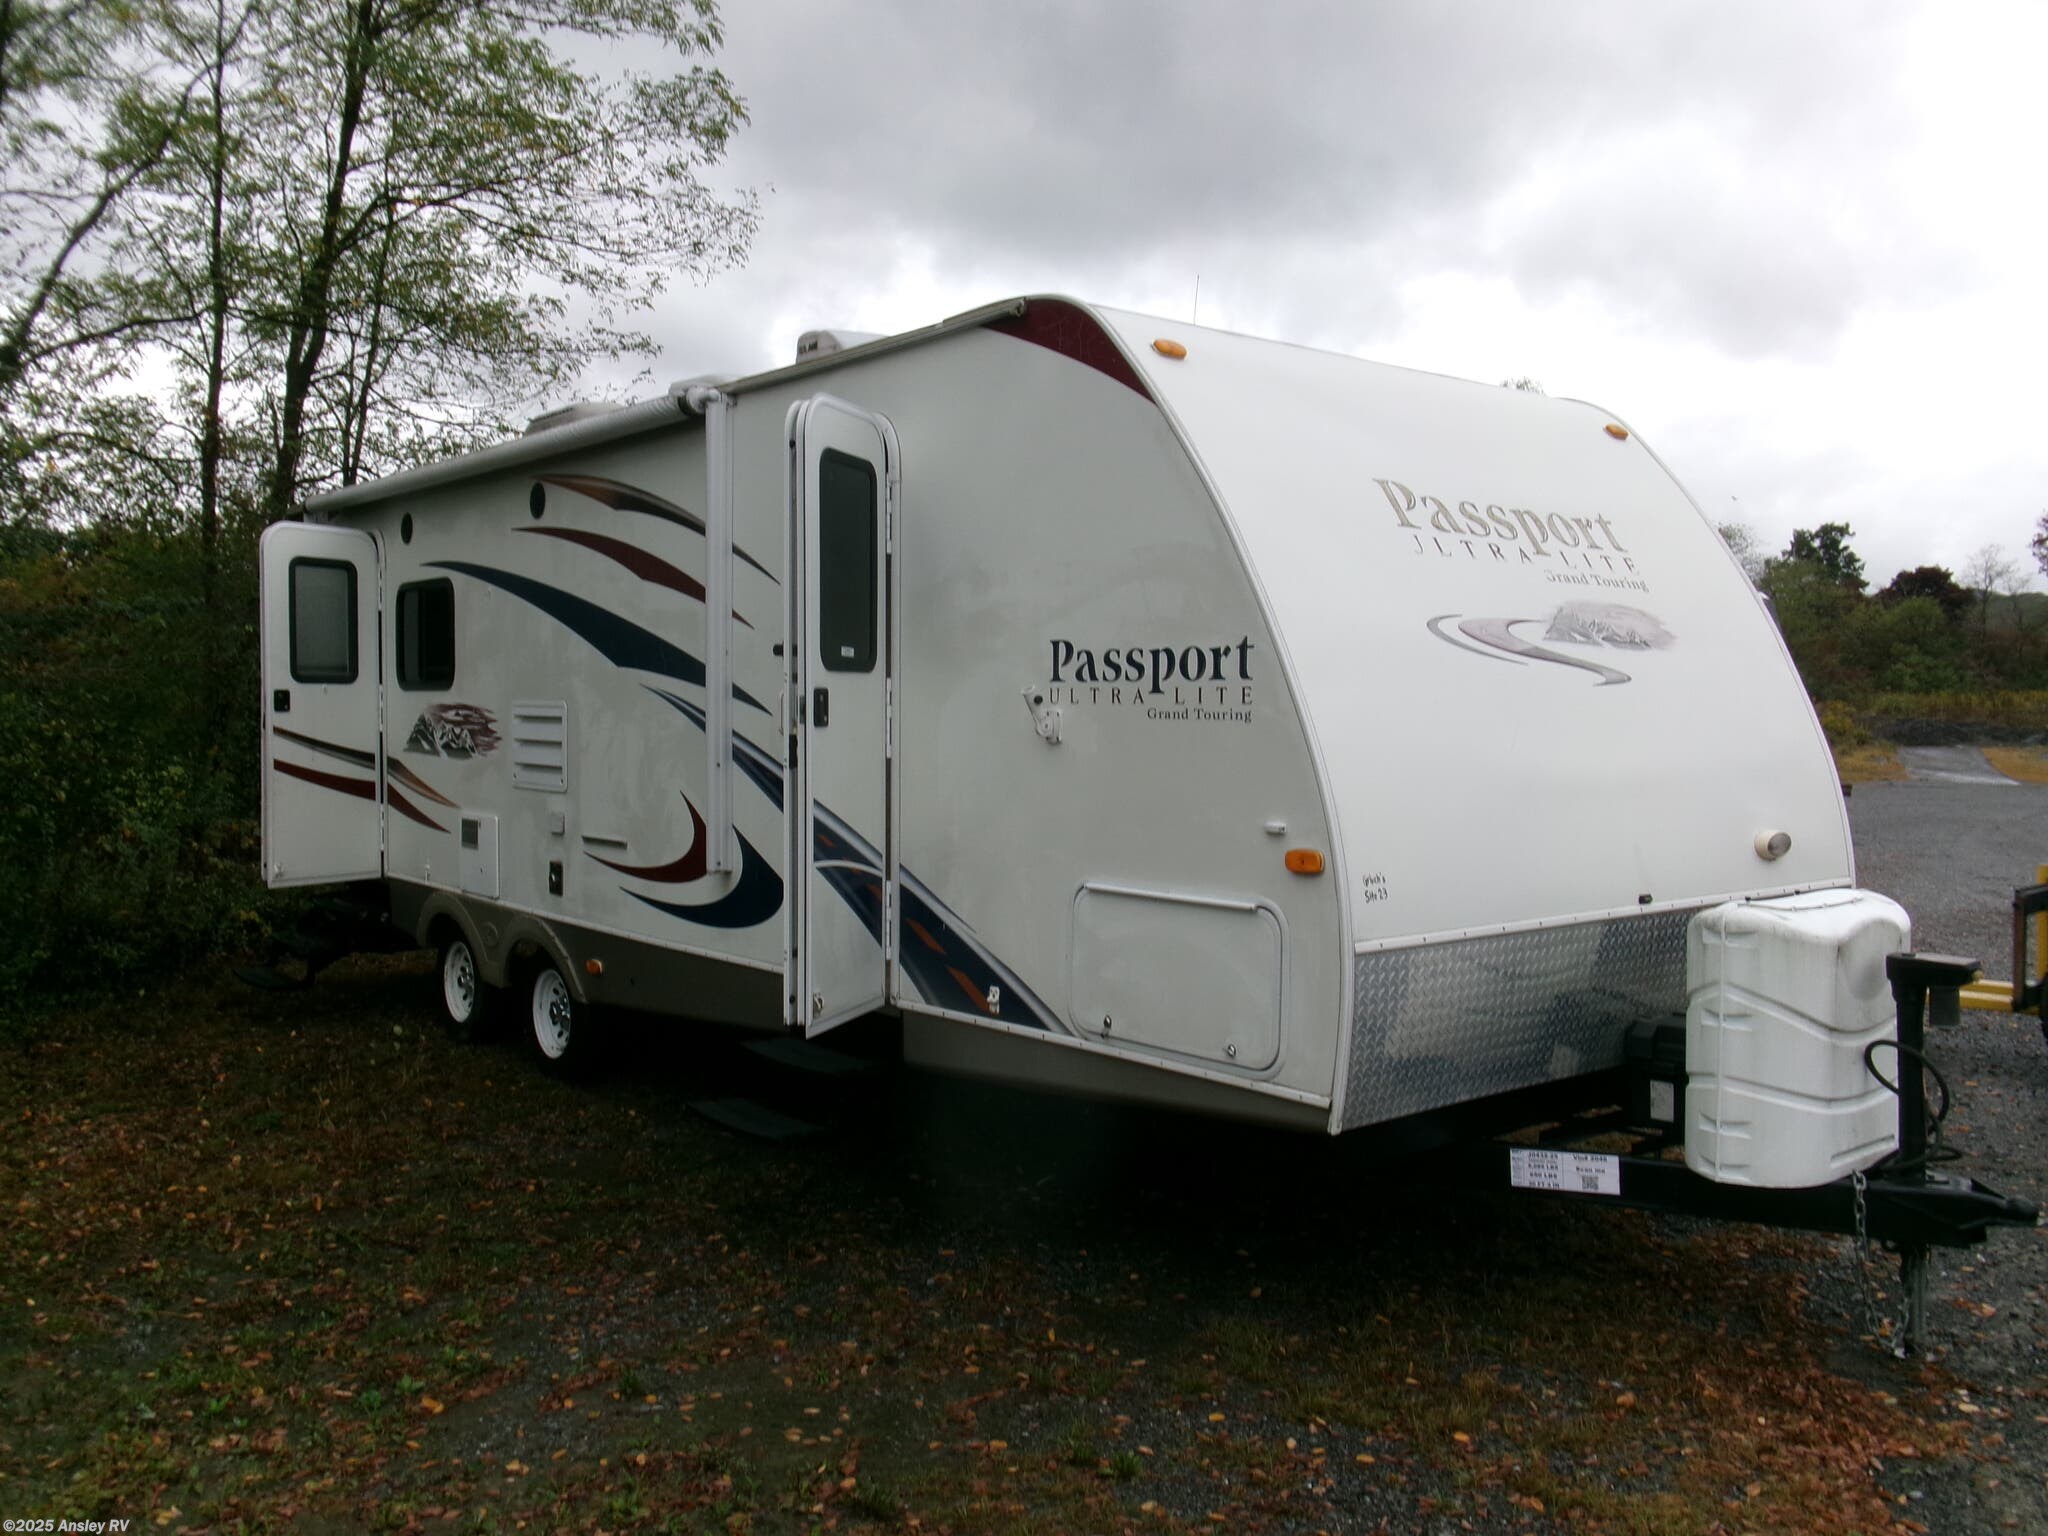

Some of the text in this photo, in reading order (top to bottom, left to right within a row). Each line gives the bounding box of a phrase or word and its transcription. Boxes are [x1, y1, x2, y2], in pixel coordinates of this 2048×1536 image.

[1373, 477, 1628, 557] Passport
[1590, 573, 1650, 593] Touring
[1050, 635, 1254, 694] Passport
[1049, 686, 1253, 704] ULTRA LITE
[1147, 707, 1252, 723] Grand Touring
